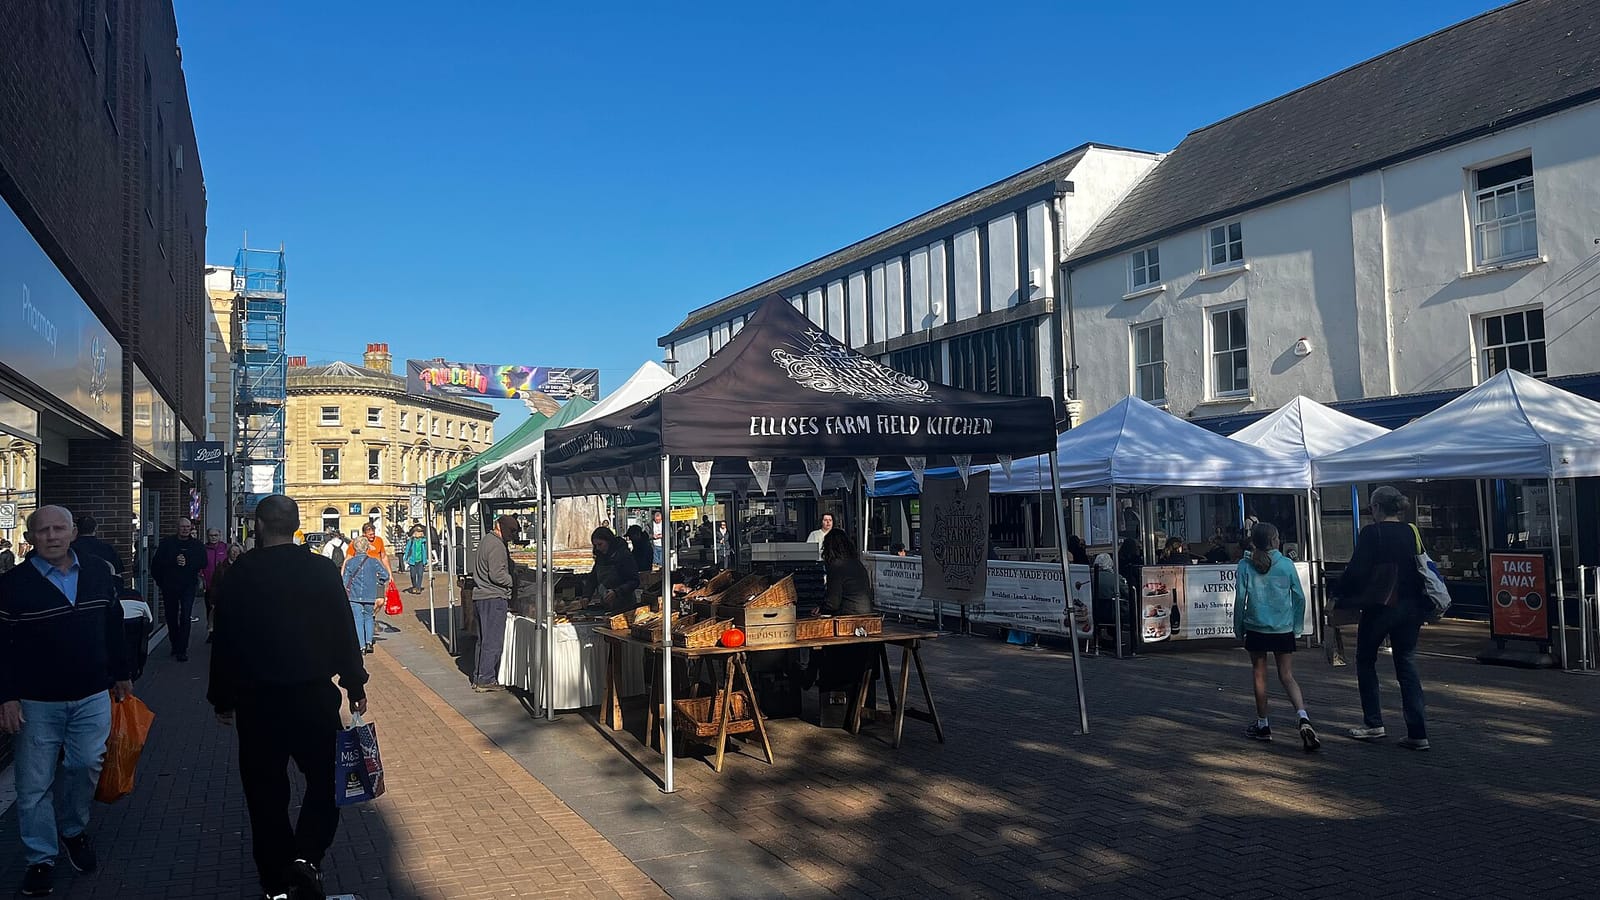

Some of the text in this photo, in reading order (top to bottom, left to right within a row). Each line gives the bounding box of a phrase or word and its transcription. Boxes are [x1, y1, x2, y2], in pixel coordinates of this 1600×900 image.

[22, 283, 58, 358] Pharmacy
[419, 367, 488, 394] PINOCCHIO
[750, 414, 993, 436] ELLISES FARM FIELD KITCHEN
[194, 448, 222, 461] Boots
[946, 528, 972, 541] FARM
[948, 547, 971, 564] PORK
[987, 567, 1018, 578] FRESHLY
[1020, 569, 1041, 580] MADE
[1502, 561, 1532, 573] TAKE
[1203, 583, 1236, 593] AFTERN
[1500, 575, 1536, 588] AWAY
[1194, 602, 1209, 610] Baby
[1195, 627, 1215, 636] 01823
[341, 749, 360, 763] M&S
